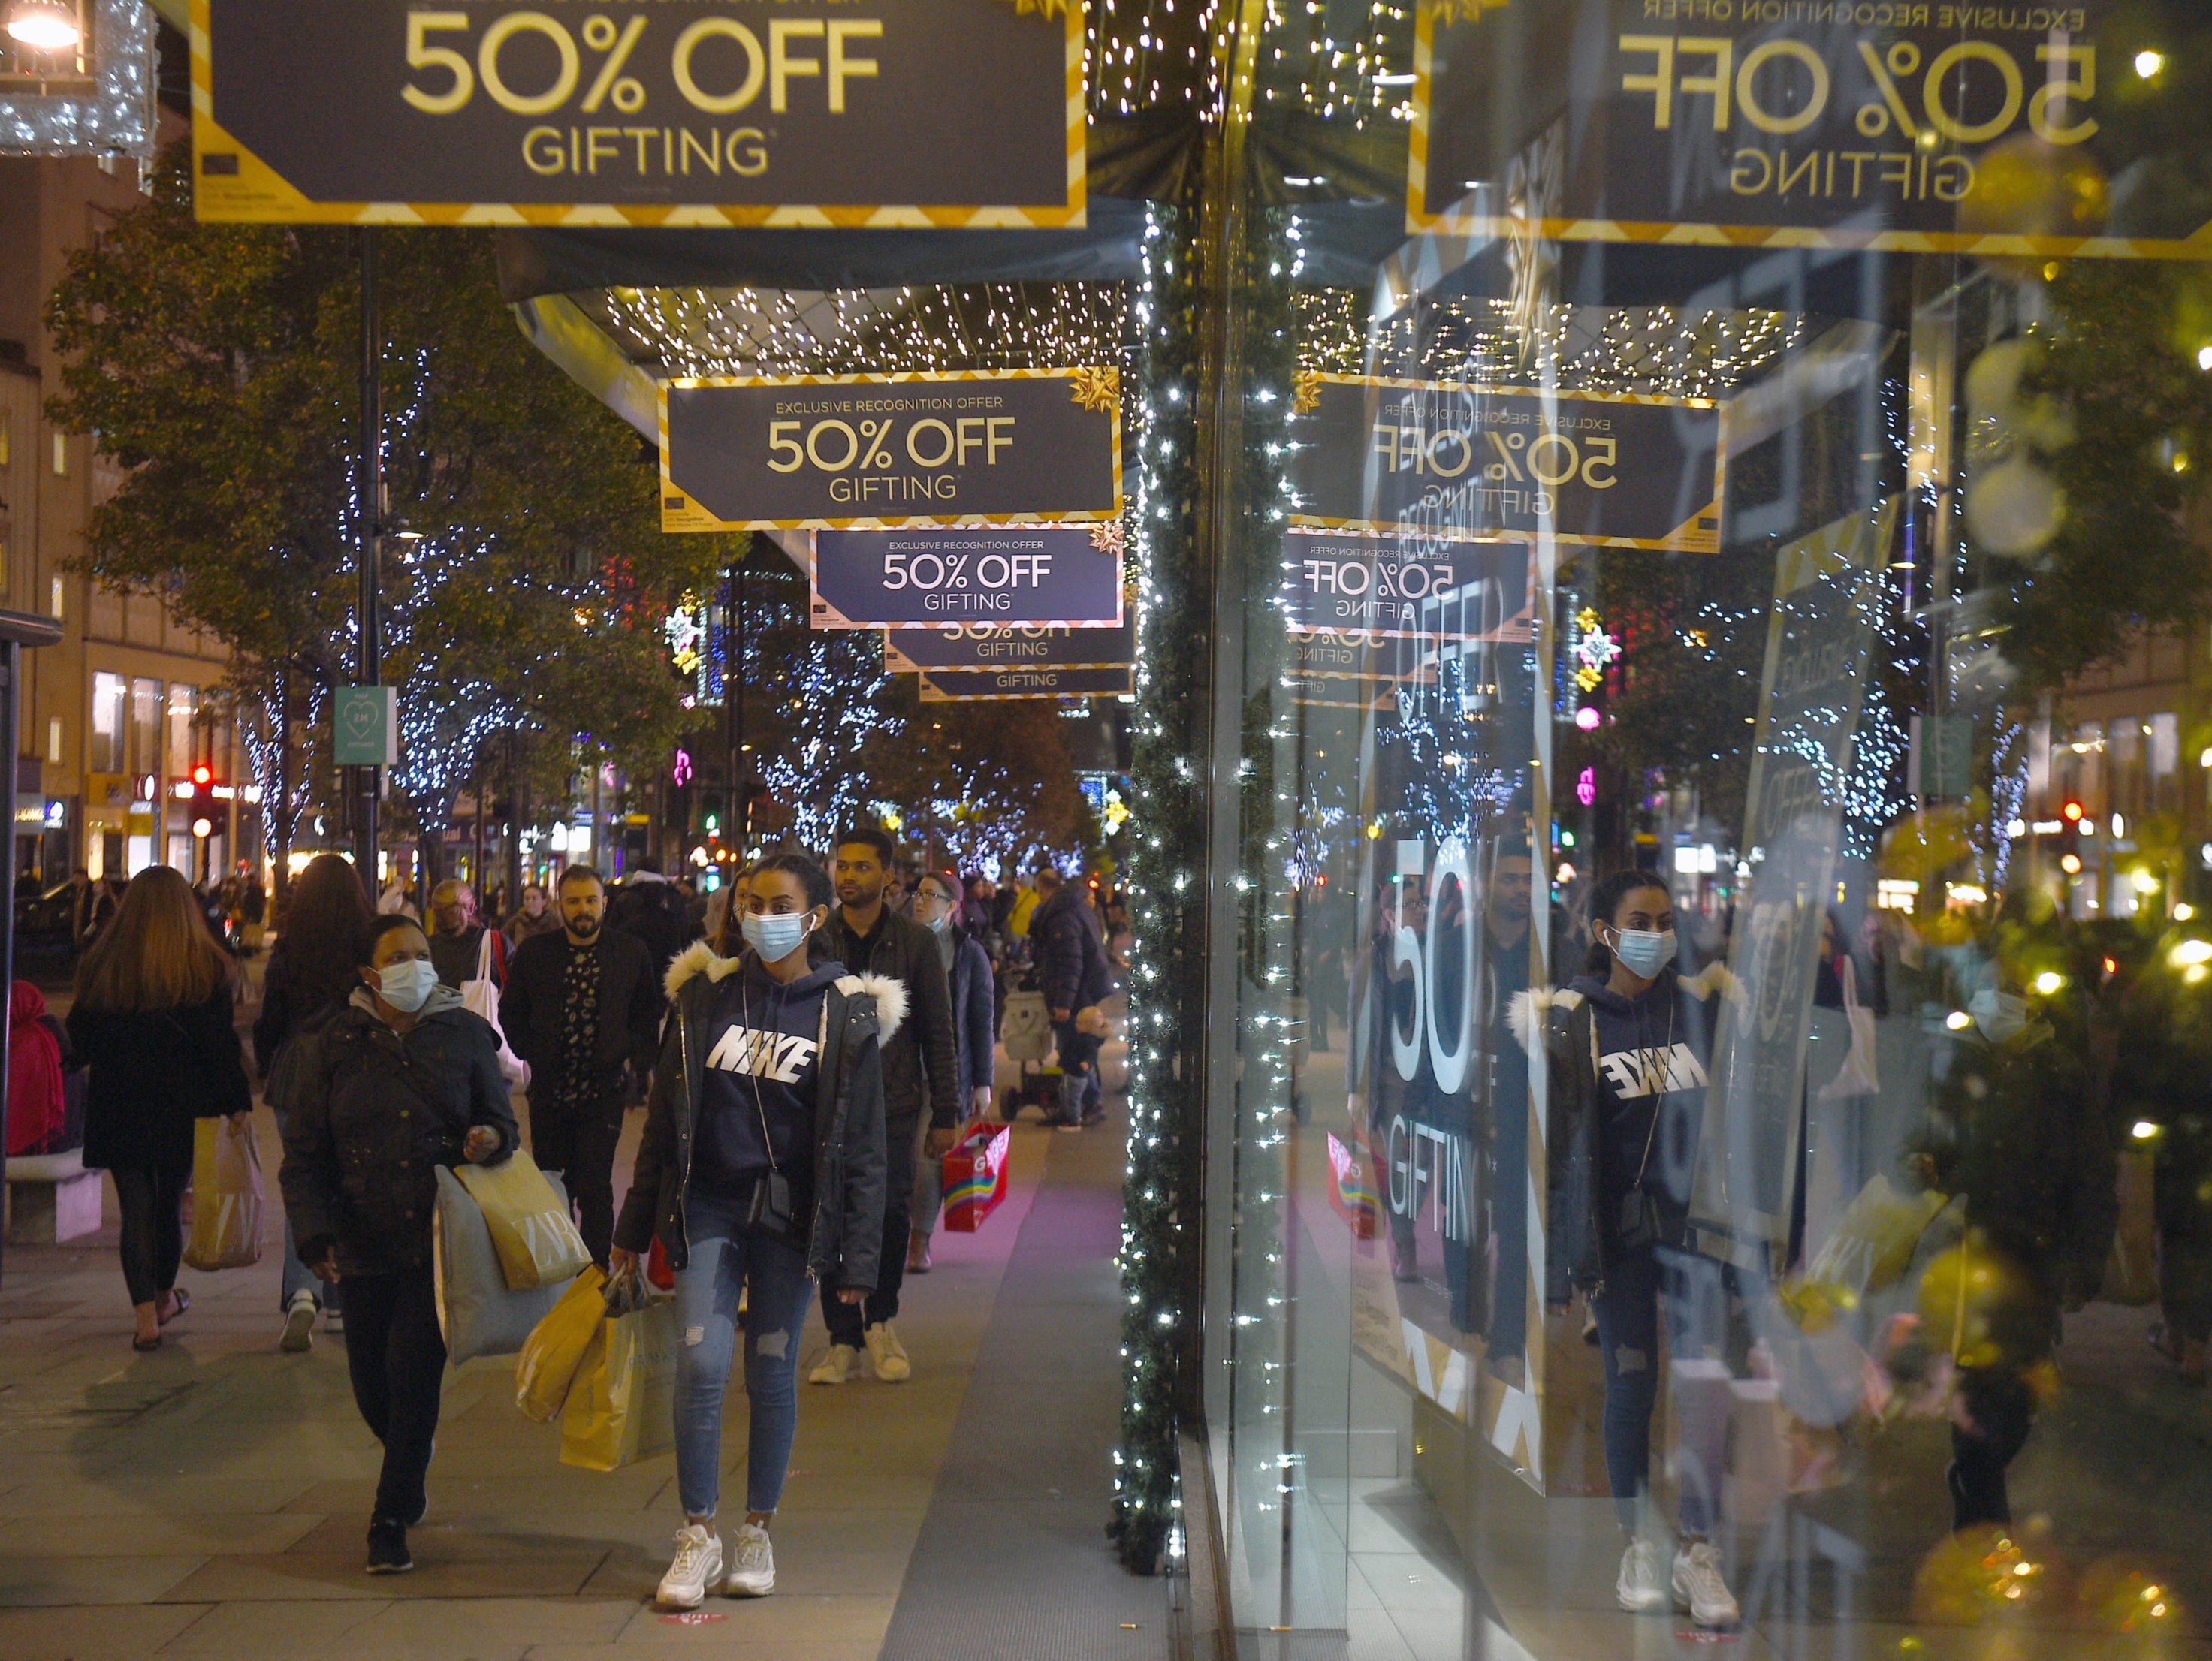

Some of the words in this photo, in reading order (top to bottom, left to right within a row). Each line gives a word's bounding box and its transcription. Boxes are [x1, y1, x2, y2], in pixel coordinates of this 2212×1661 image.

[402, 11, 648, 114] 50%
[672, 15, 885, 114] OFF
[522, 125, 769, 177] GIFTING
[776, 401, 850, 414] EXCLUSIVE
[856, 398, 952, 412] RECOGNITION
[957, 396, 1003, 408] OFFER
[766, 418, 894, 473] 50%
[906, 417, 1015, 468] OFF
[829, 475, 957, 502] GIFTING
[889, 541, 941, 550] EXCLUSIVE
[944, 541, 1009, 550] RECOGNITION
[1012, 541, 1044, 549] OFFER
[883, 553, 969, 590] 50%
[977, 554, 1052, 588] OFF
[924, 593, 1011, 610] GIFTING
[976, 642, 1049, 656] GIFTING
[997, 674, 1058, 687] GIFTING
[705, 1024, 819, 1085] NIKE
[1390, 1114, 1492, 1254] GIFTIN
[509, 1210, 593, 1267] ZAR
